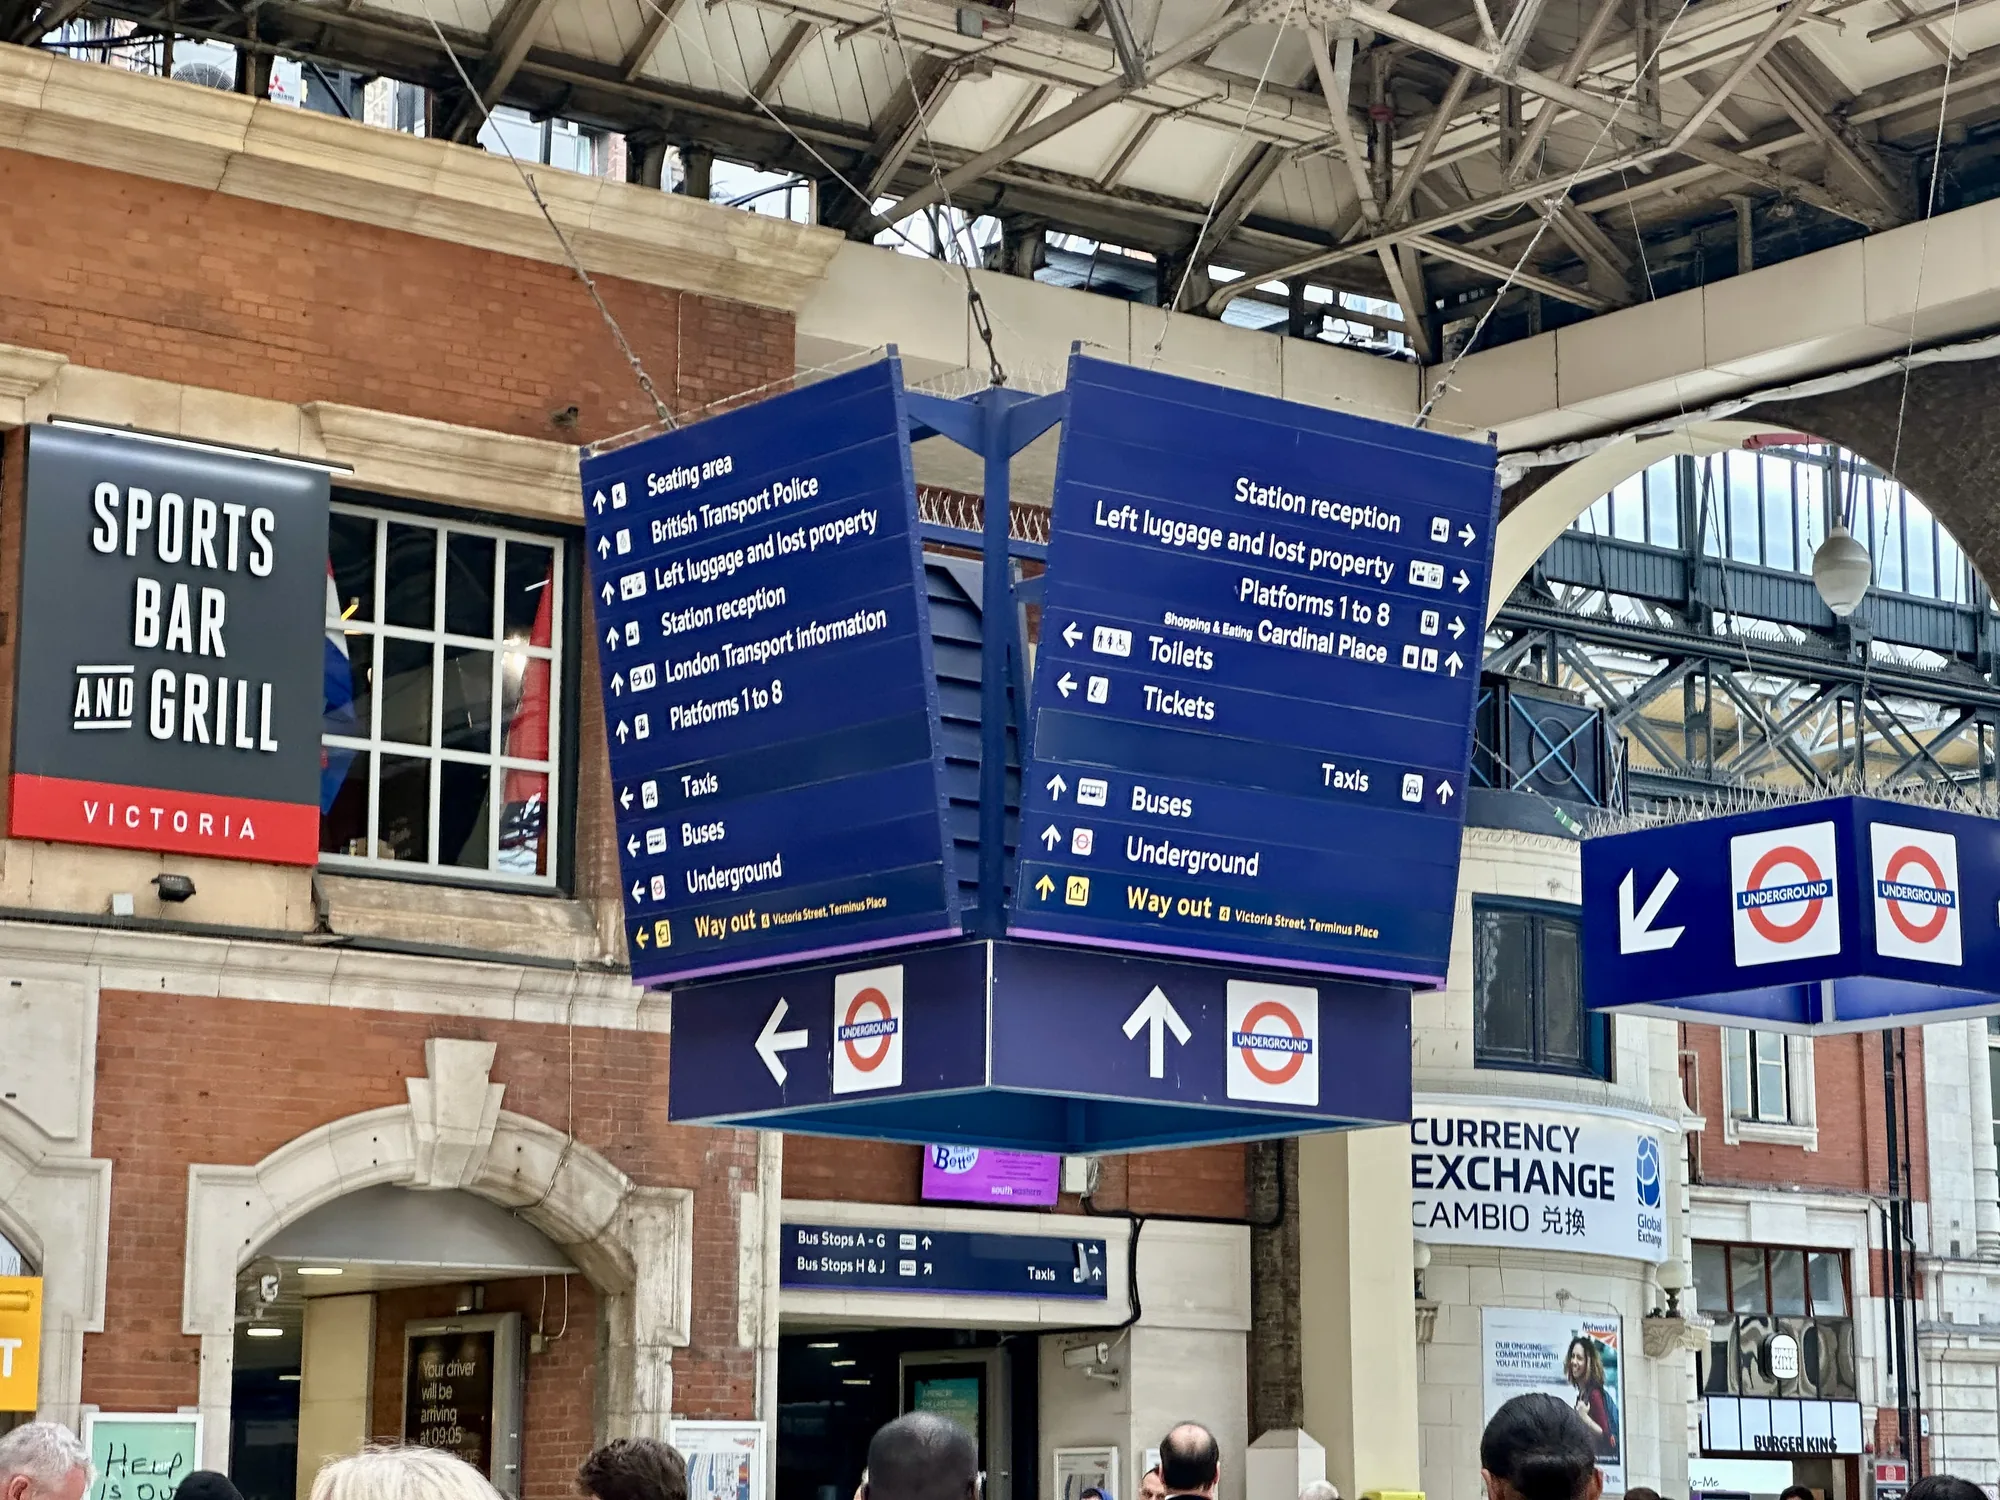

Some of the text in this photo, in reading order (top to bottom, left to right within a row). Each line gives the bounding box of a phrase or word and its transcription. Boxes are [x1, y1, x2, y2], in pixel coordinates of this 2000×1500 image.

[648, 455, 732, 497] Seating area
[652, 475, 819, 544] British Transport Police
[1235, 477, 1401, 533] Station reception
[93, 481, 276, 577] SPORTS
[1095, 500, 1395, 584] Left luggage and lost property
[655, 508, 877, 591] Left luggage and lost property
[134, 577, 226, 658] BAR
[661, 584, 785, 636] Station reception
[1240, 578, 1390, 627] Platforms 1 to 8
[665, 608, 886, 683] London Transport information
[1148, 636, 1213, 671] Toilets
[1164, 611, 1387, 664] Shopping & Eating Cardinal Place
[74, 667, 278, 753] AND GRILL
[670, 680, 783, 731] Platforms 1 to 8
[1143, 685, 1215, 721] Tickets
[681, 772, 718, 798] Taxis
[1322, 763, 1369, 793] Taxis
[1131, 786, 1192, 818] Buses
[83, 800, 256, 841] VICTORIA
[682, 819, 725, 848] Buses
[1126, 835, 1259, 877] Underground
[687, 853, 782, 894] Underground
[1742, 882, 1828, 907] UNDERGROUND
[1881, 883, 1951, 905] UNDERGROUND
[695, 914, 728, 940] Way
[731, 909, 756, 932] out
[773, 910, 803, 925] Victoria
[803, 906, 828, 921] Street,
[829, 899, 864, 917] Terminus
[866, 896, 887, 910] Place
[1127, 886, 1172, 917] Way
[1177, 896, 1212, 919] out
[1235, 909, 1273, 926] Victoria
[1275, 913, 1306, 931] Street,
[1309, 918, 1352, 936] Terminus
[1354, 924, 1379, 939] Place
[841, 1021, 895, 1039] UNDERGROUND
[1237, 1034, 1308, 1052] UNDERGROUND
[1411, 1118, 1581, 1154] CURRENCY
[991, 1185, 1042, 1197] southeastern
[1412, 1154, 1615, 1201] EXCHANGE
[1412, 1201, 1529, 1233] CAMBIO
[1638, 1213, 1661, 1232] Global
[798, 1230, 818, 1245] Bus
[822, 1231, 854, 1247] Stops
[857, 1234, 866, 1246] A
[876, 1234, 886, 1247] G
[1638, 1229, 1662, 1249] Exchange
[797, 1257, 886, 1274] Bus Stops H & J
[1027, 1266, 1055, 1281] Taxis
[1496, 1341, 1542, 1351] OUR ONGOING
[1496, 1351, 1540, 1360] COMMITMENT
[423, 1358, 475, 1378] Your driver
[1496, 1359, 1552, 1369] YOU AT ITS HEART
[422, 1381, 452, 1400] will be
[421, 1404, 457, 1426] arriving
[420, 1427, 461, 1445] at 09:05
[1754, 1435, 1837, 1453] BURGER KING
[106, 1442, 182, 1479] HELP
